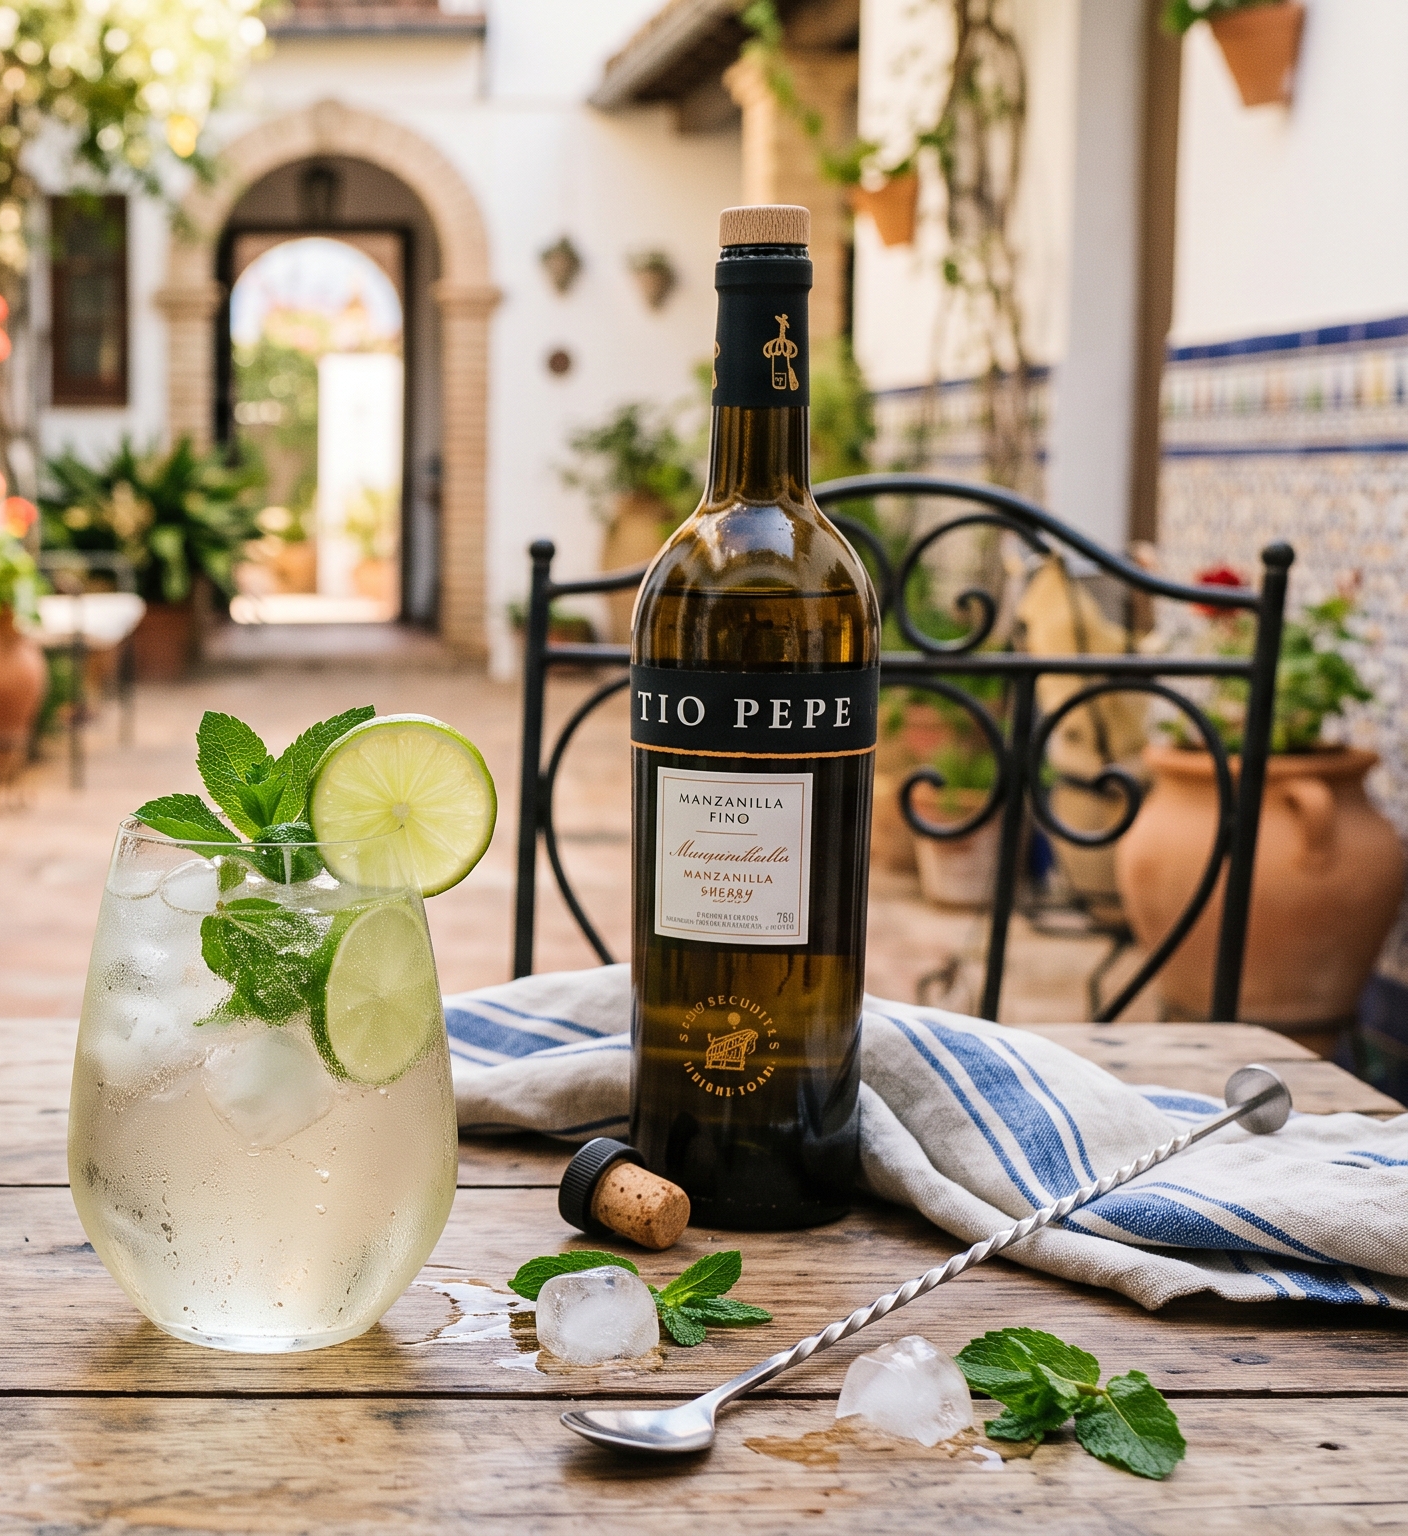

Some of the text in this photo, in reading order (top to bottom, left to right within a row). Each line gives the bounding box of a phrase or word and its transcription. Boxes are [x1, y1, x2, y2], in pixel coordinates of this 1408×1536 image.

[638, 691, 851, 729] TIO PEPE
[679, 793, 784, 809] MANZANILLA
[709, 811, 750, 825] FINO
[683, 869, 773, 884] MANZANILLA
